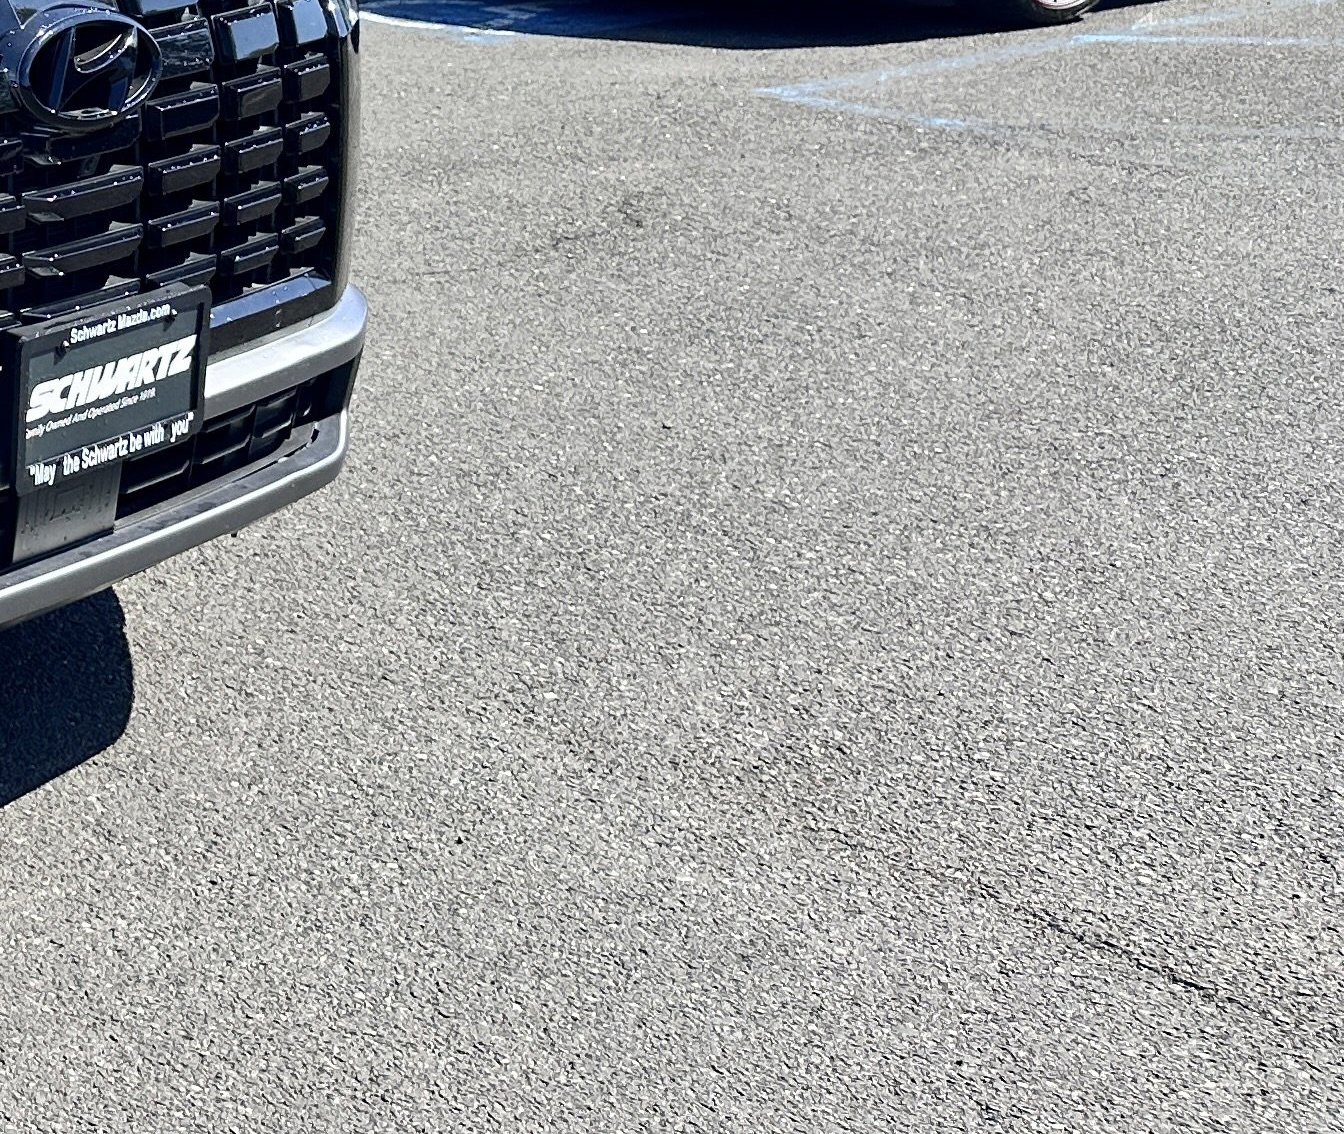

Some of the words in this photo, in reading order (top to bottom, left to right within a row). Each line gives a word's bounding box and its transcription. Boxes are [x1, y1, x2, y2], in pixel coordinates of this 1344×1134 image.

[70, 318, 117, 344] Schwartz
[116, 304, 171, 330] Mazda.com
[26, 334, 197, 423] SCHWARTZ
[29, 462, 56, 486] "May
[63, 453, 80, 476] the
[82, 437, 128, 469] Schwartz
[129, 430, 143, 453] be
[144, 422, 165, 447] with
[170, 411, 194, 443] you"
